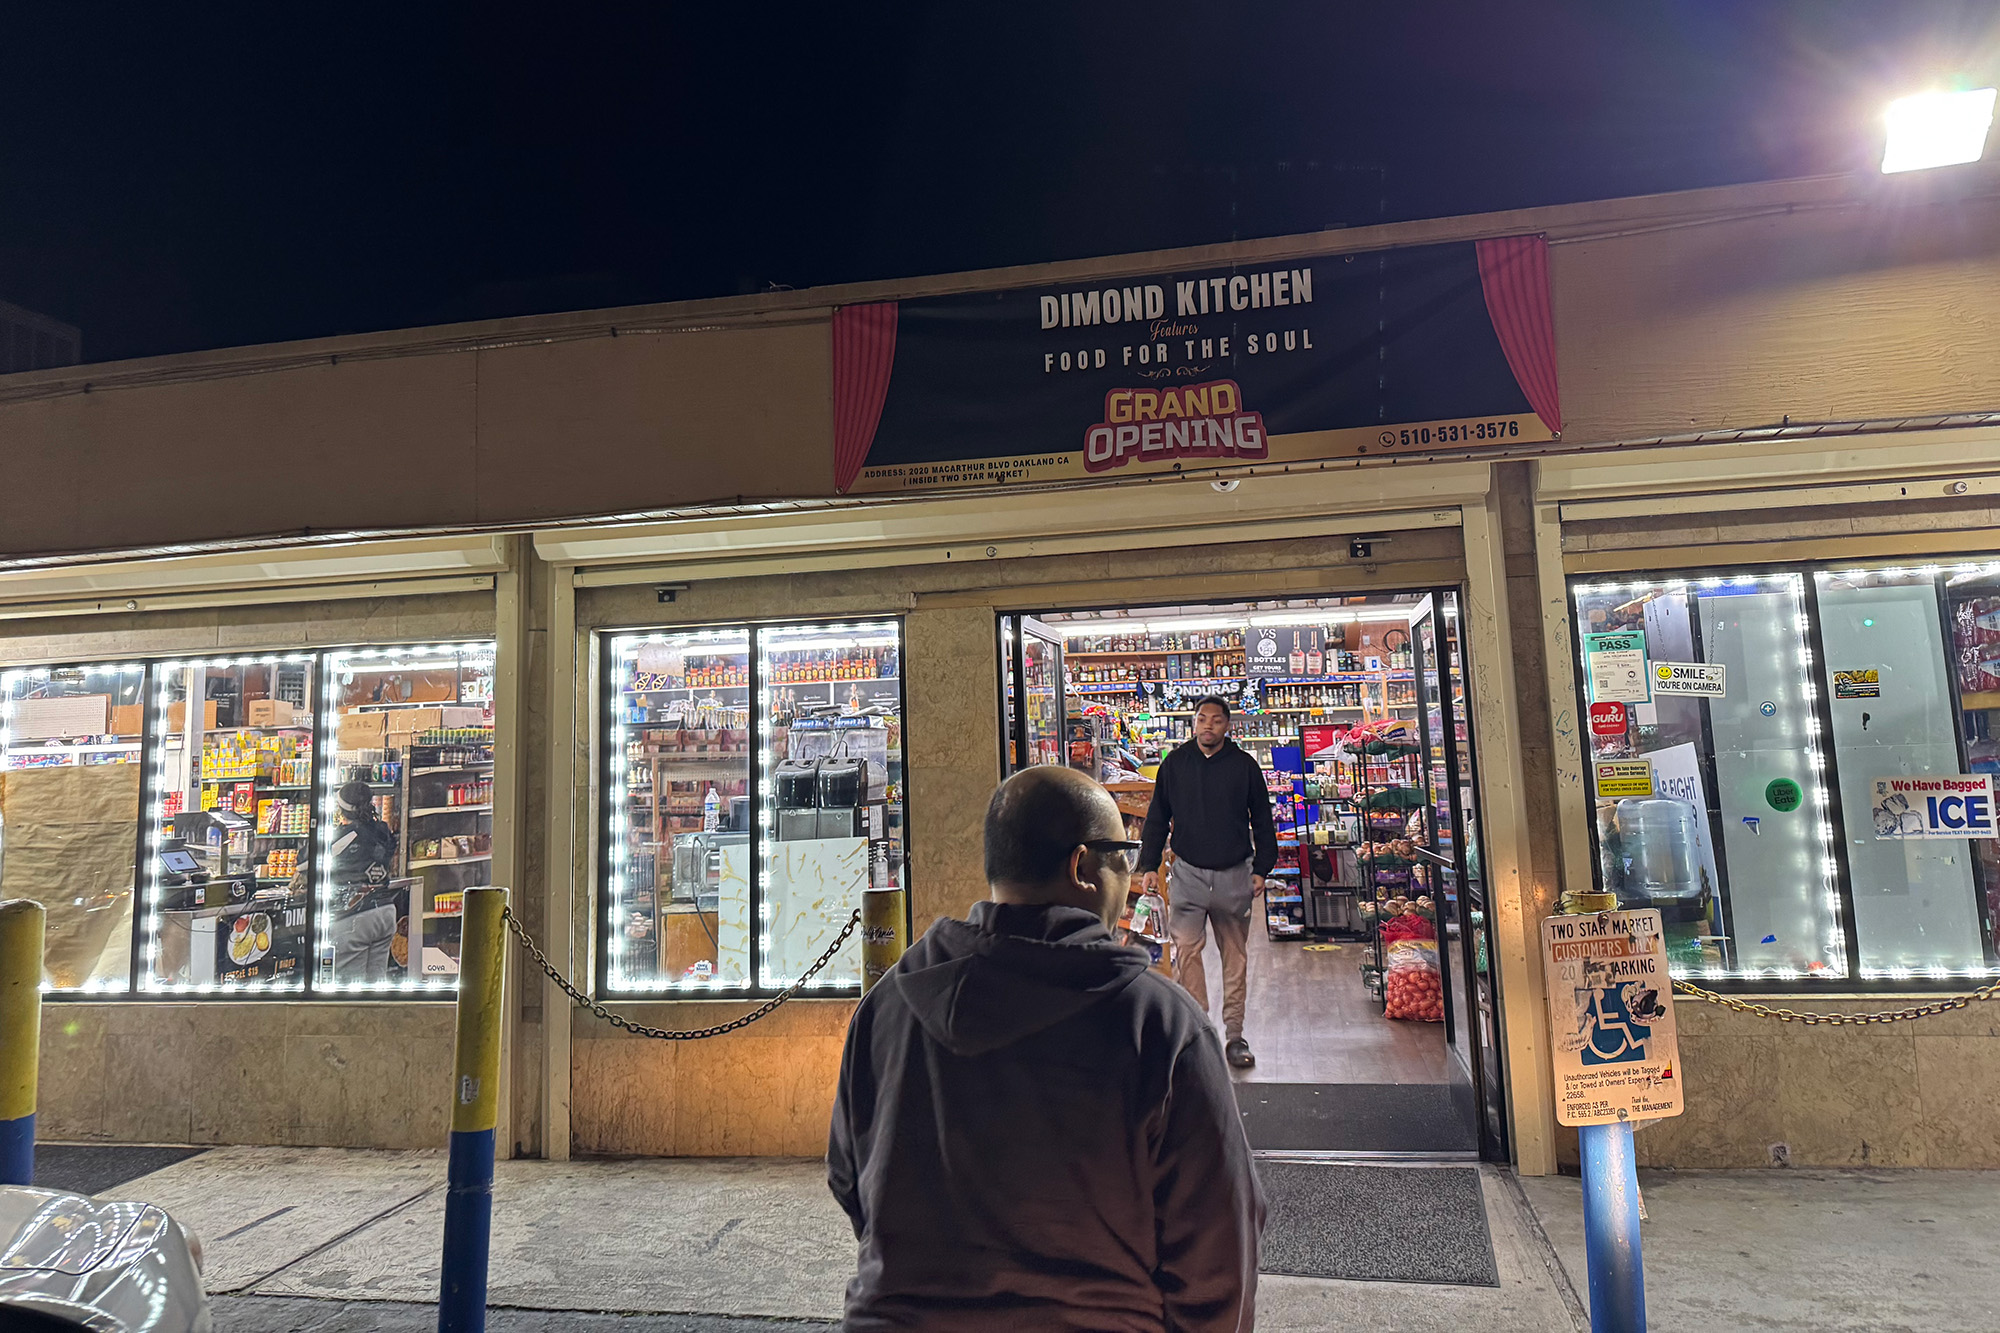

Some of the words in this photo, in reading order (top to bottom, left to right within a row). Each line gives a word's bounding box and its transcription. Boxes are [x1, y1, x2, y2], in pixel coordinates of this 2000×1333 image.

[1040, 284, 1165, 329] DIMOND
[1176, 268, 1313, 316] KITCHEN
[1150, 318, 1199, 342] Features
[1044, 349, 1106, 373] FOOD
[1123, 343, 1168, 366] FOR
[1185, 336, 1230, 360] THE
[1247, 329, 1313, 355] SOUL
[1109, 383, 1237, 424] GRAND
[1088, 415, 1263, 463] OPENING
[1400, 420, 1519, 446] 510-531-3576
[864, 467, 906, 479] ADDRESS:
[909, 466, 929, 476] 2020
[931, 463, 985, 474] MACARTHUR
[988, 460, 1010, 470] BLVD
[1013, 457, 1054, 468] OAKLAND
[1057, 456, 1069, 464] CA
[909, 475, 938, 485] INSIDE
[941, 473, 960, 483] TWO
[964, 472, 984, 481] STAR
[988, 470, 1023, 481] MARKET
[1599, 640, 1631, 651] PASS
[1673, 667, 1706, 680] SMILE
[1657, 680, 1680, 690] YOU'RE
[1681, 681, 1692, 691] ON
[1693, 682, 1722, 692] CAMERA
[1593, 713, 1624, 723] GURU
[1773, 788, 1793, 796] Uber
[1891, 780, 1911, 791] We
[1912, 779, 1941, 791] Have
[1943, 778, 1986, 792] Bagged
[1774, 796, 1796, 804] Eats
[1926, 795, 1991, 829] ICE
[1551, 923, 1574, 940] TWO
[1579, 920, 1607, 937] STAR
[1612, 916, 1654, 935] MARKET
[1555, 940, 1623, 961] CUSTOMERS
[1627, 936, 1654, 954] ONLY
[1561, 965, 1576, 981] 20
[1613, 958, 1656, 976] ARKING
[1564, 1071, 1599, 1082] Unauthorized
[1599, 1069, 1621, 1078] Vehicles
[1622, 1067, 1631, 1076] will
[1632, 1067, 1640, 1075] be
[1641, 1065, 1660, 1076] Tagged
[1580, 1081, 1597, 1089] Towed
[1627, 1076, 1648, 1085] Expen
[1567, 1102, 1591, 1111] ENFORCED
[1592, 1101, 1599, 1109] AS
[1600, 1100, 1609, 1108] PER
[1641, 1102, 1673, 1111] MANAGEMENT
